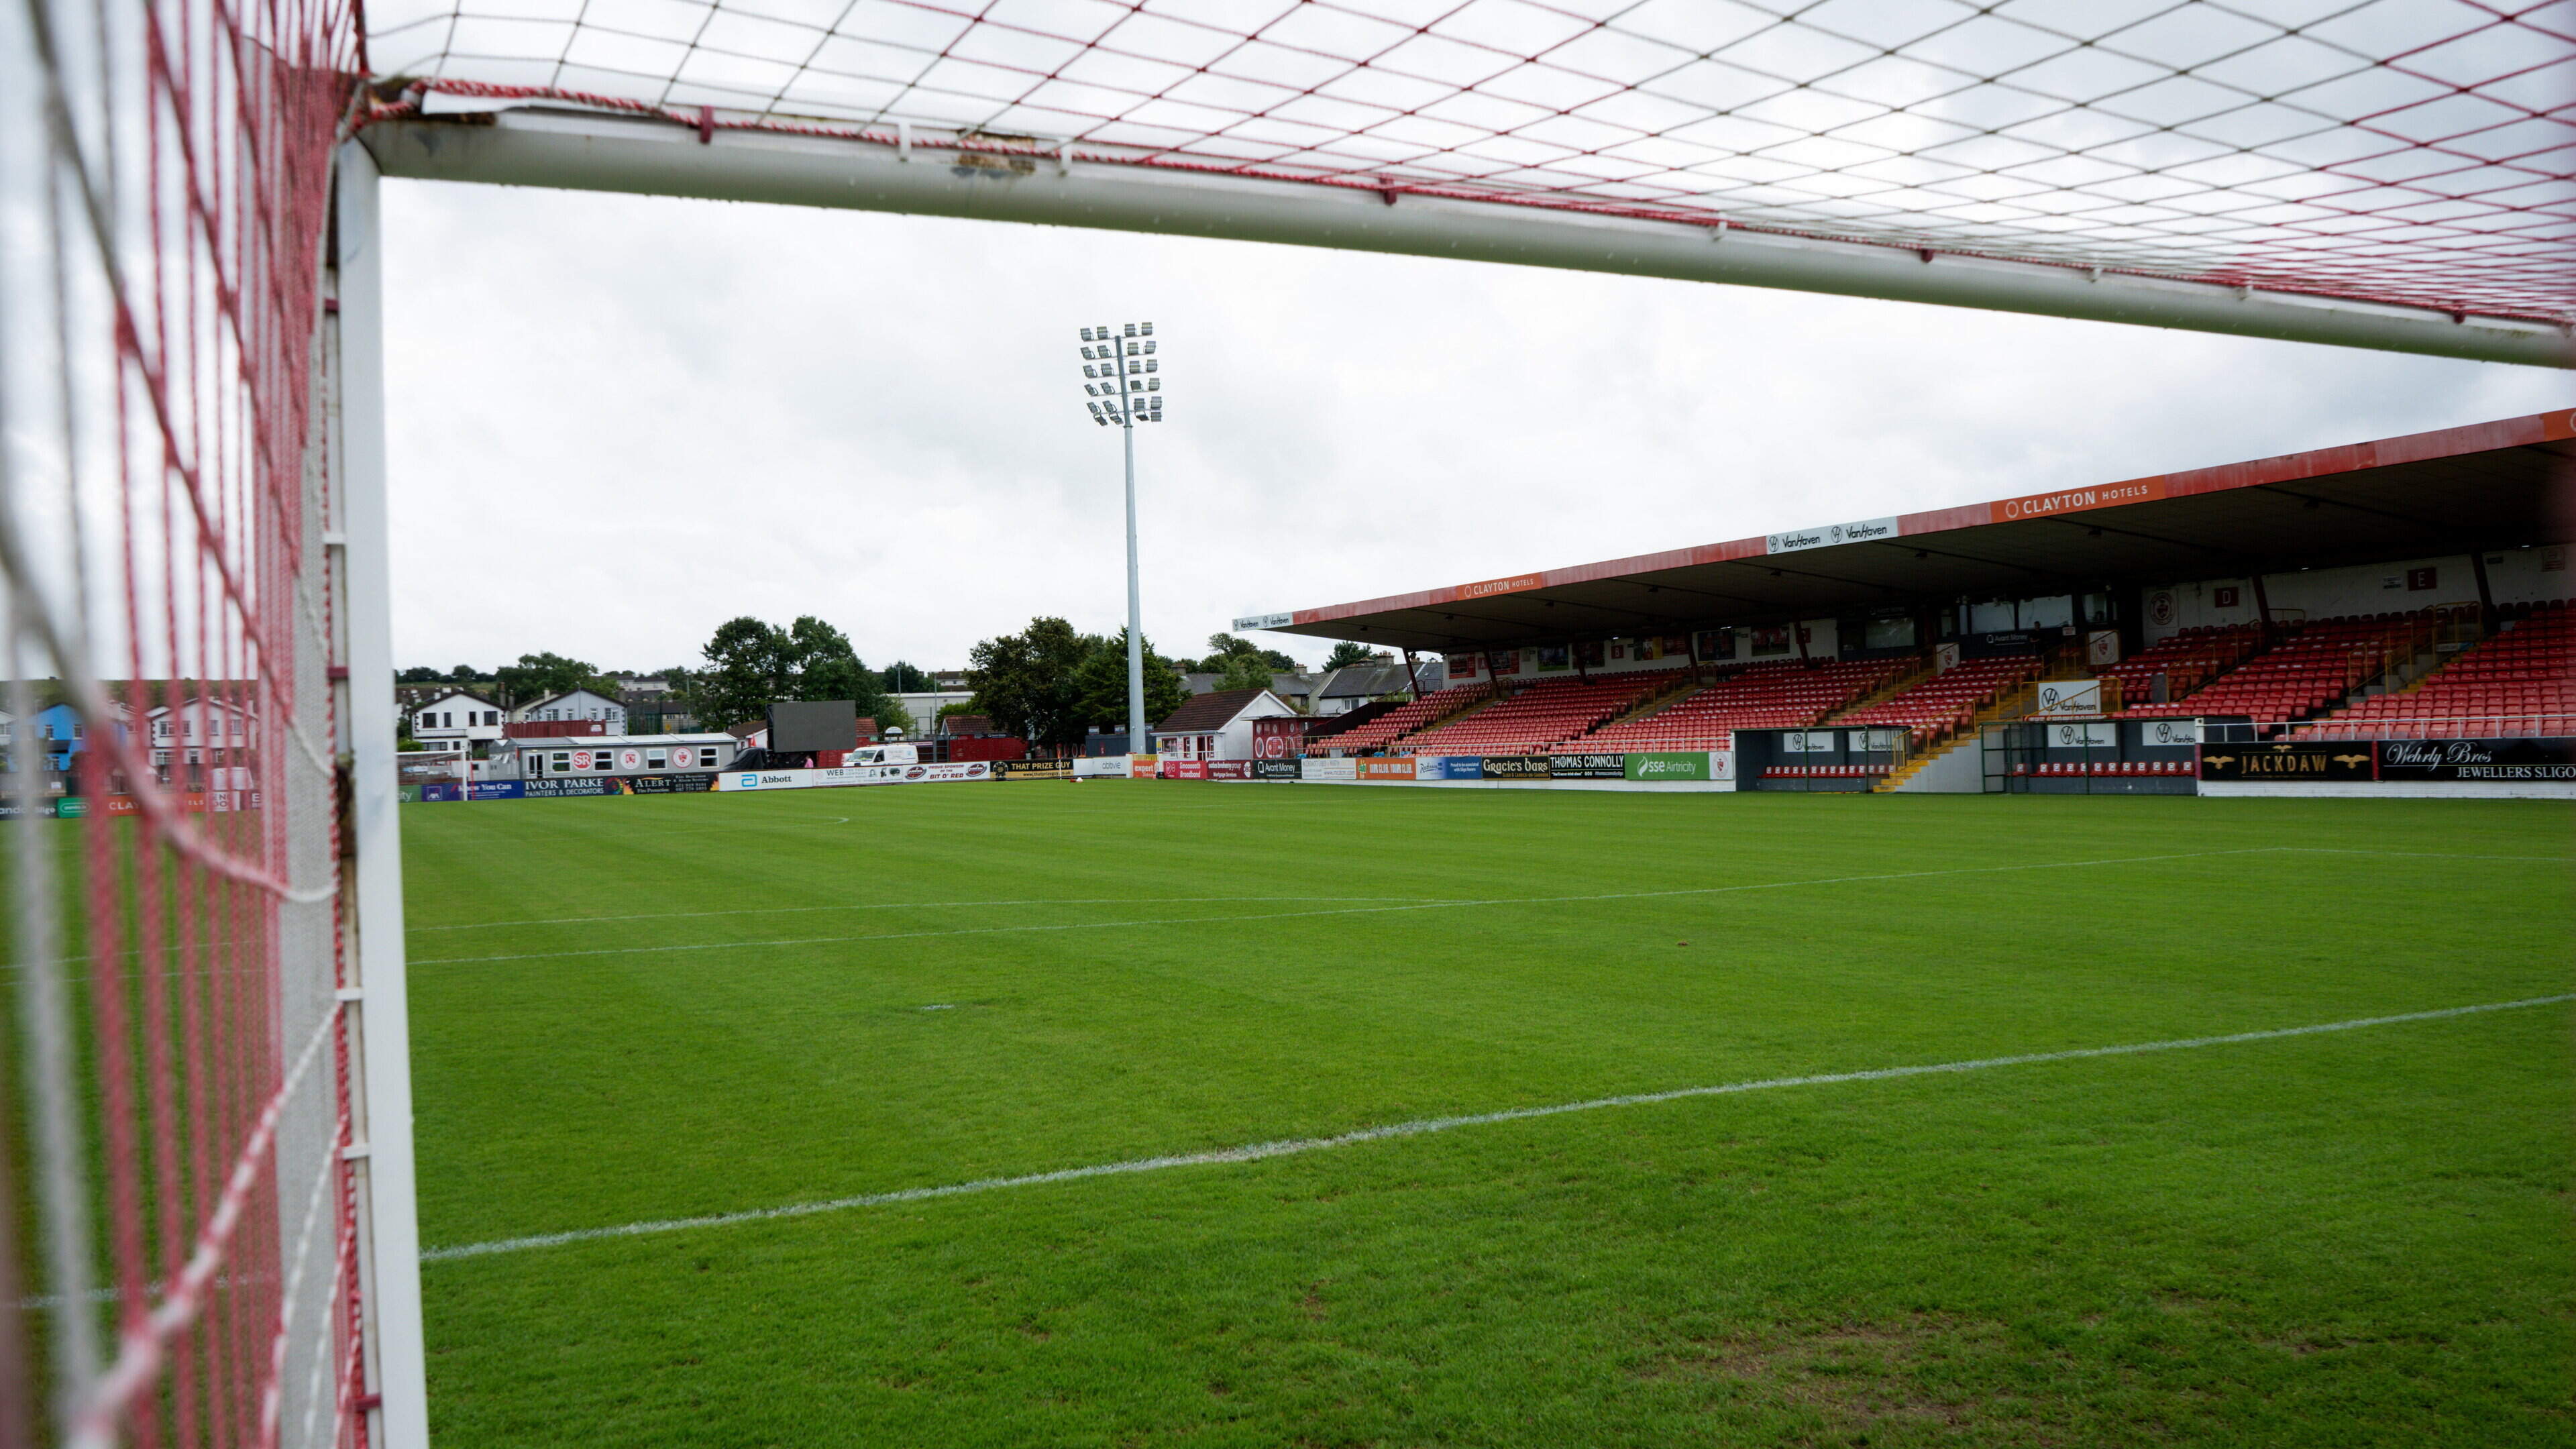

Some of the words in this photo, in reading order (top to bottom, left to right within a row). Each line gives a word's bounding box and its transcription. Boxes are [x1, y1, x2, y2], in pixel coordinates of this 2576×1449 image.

[2023, 490, 2096, 514] CLAYTON
[2102, 485, 2147, 500] HOTELS
[1846, 524, 1886, 539] VanHaven
[1782, 534, 1821, 548] VanHaven
[2418, 572, 2426, 586] E
[1474, 580, 1509, 595] CLAYTON
[1512, 578, 1534, 587] HOTELS
[2222, 590, 2232, 604] D
[574, 755, 591, 765] SR
[1550, 757, 1582, 768] THOMAS
[1584, 755, 1624, 767] CONNOLLY
[2387, 741, 2443, 771] Wehrly
[2447, 741, 2492, 763] Bros
[1102, 761, 1121, 769] abbvie
[1134, 765, 1153, 773] expert
[1265, 763, 1279, 771] Avant
[1279, 763, 1295, 773] Money
[1648, 761, 1666, 773] sse
[1666, 761, 1697, 775] Airtricity
[2241, 755, 2327, 774] JACKDAW
[2457, 767, 2532, 778] JEWELLERS
[2534, 766, 2576, 778] SLIGO
[525, 780, 559, 790] IVOR
[564, 778, 604, 788] PARKE
[761, 775, 792, 784] Abbott
